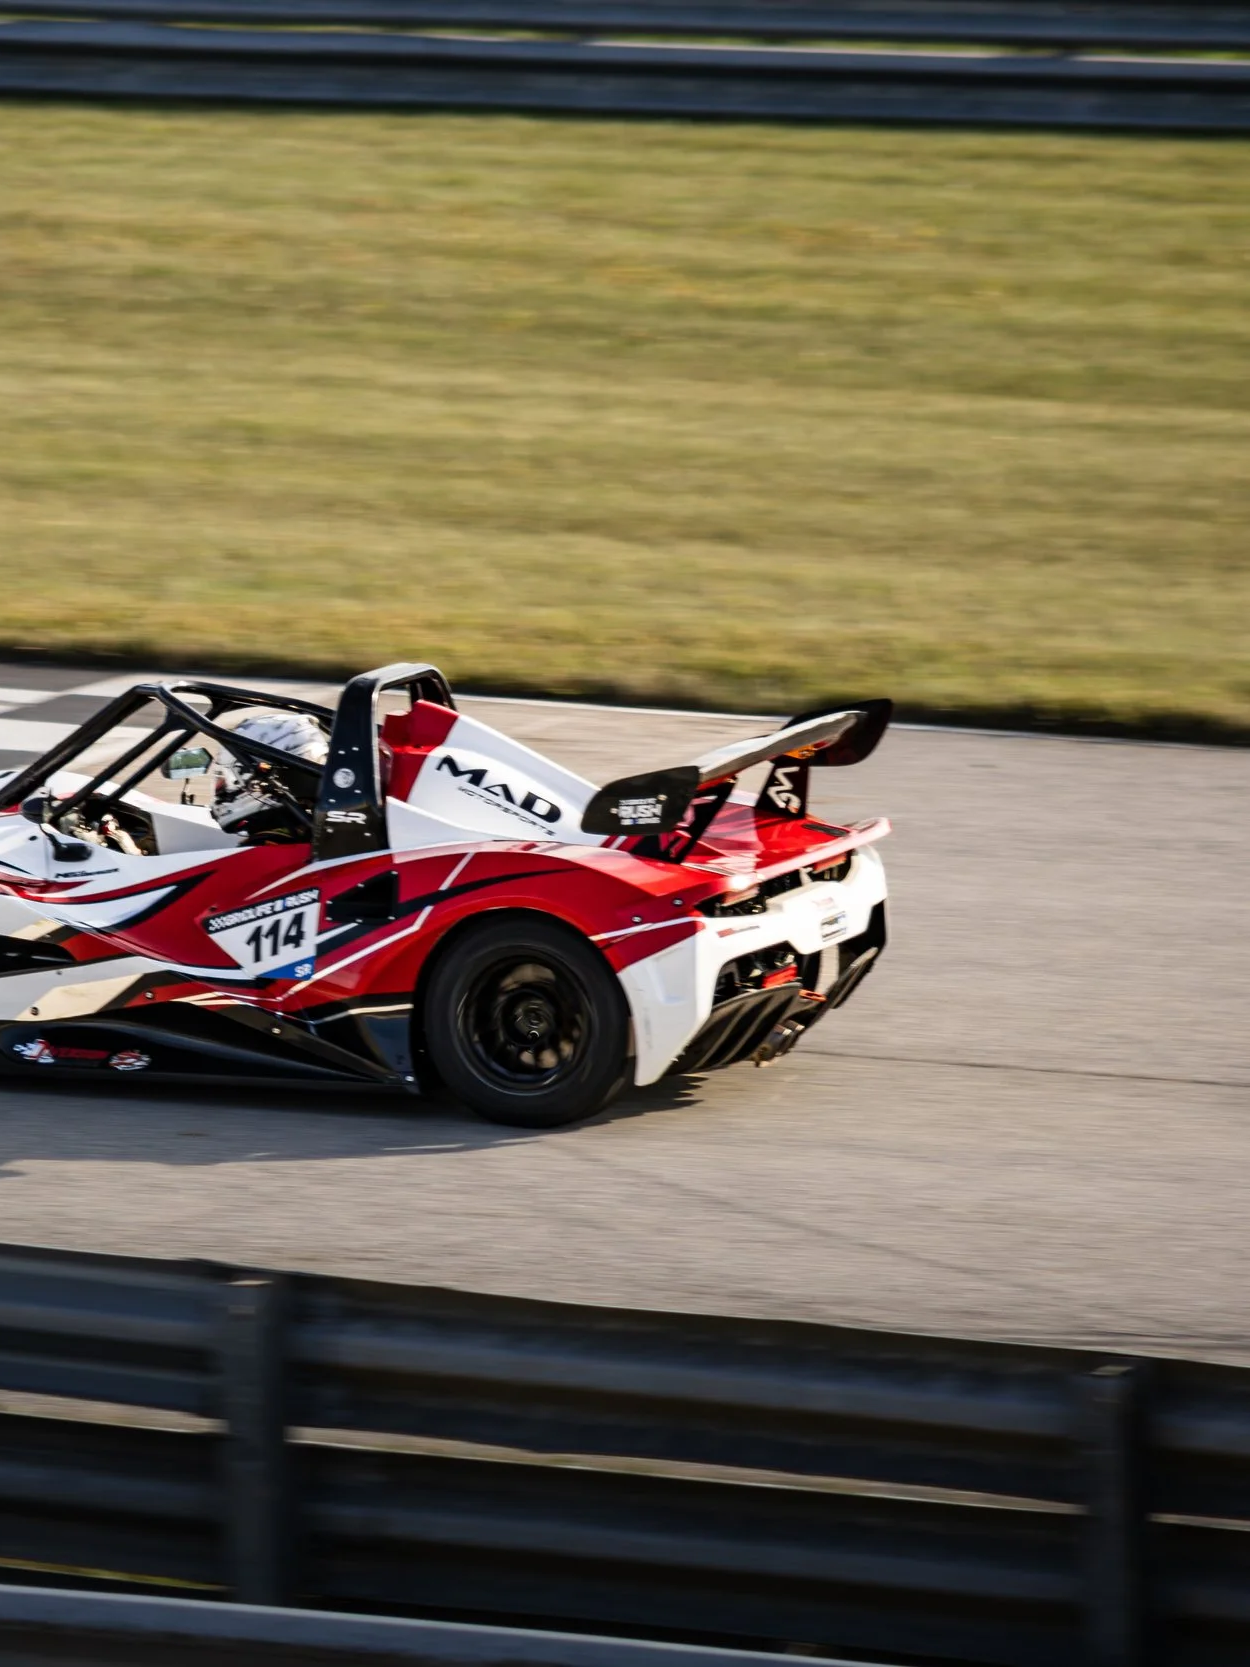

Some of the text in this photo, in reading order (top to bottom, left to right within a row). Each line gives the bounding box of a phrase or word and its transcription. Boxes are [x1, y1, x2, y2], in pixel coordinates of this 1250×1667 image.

[435, 755, 562, 823] MAD
[325, 810, 367, 824] SR
[246, 911, 306, 963] 114
[293, 962, 313, 979] SR
